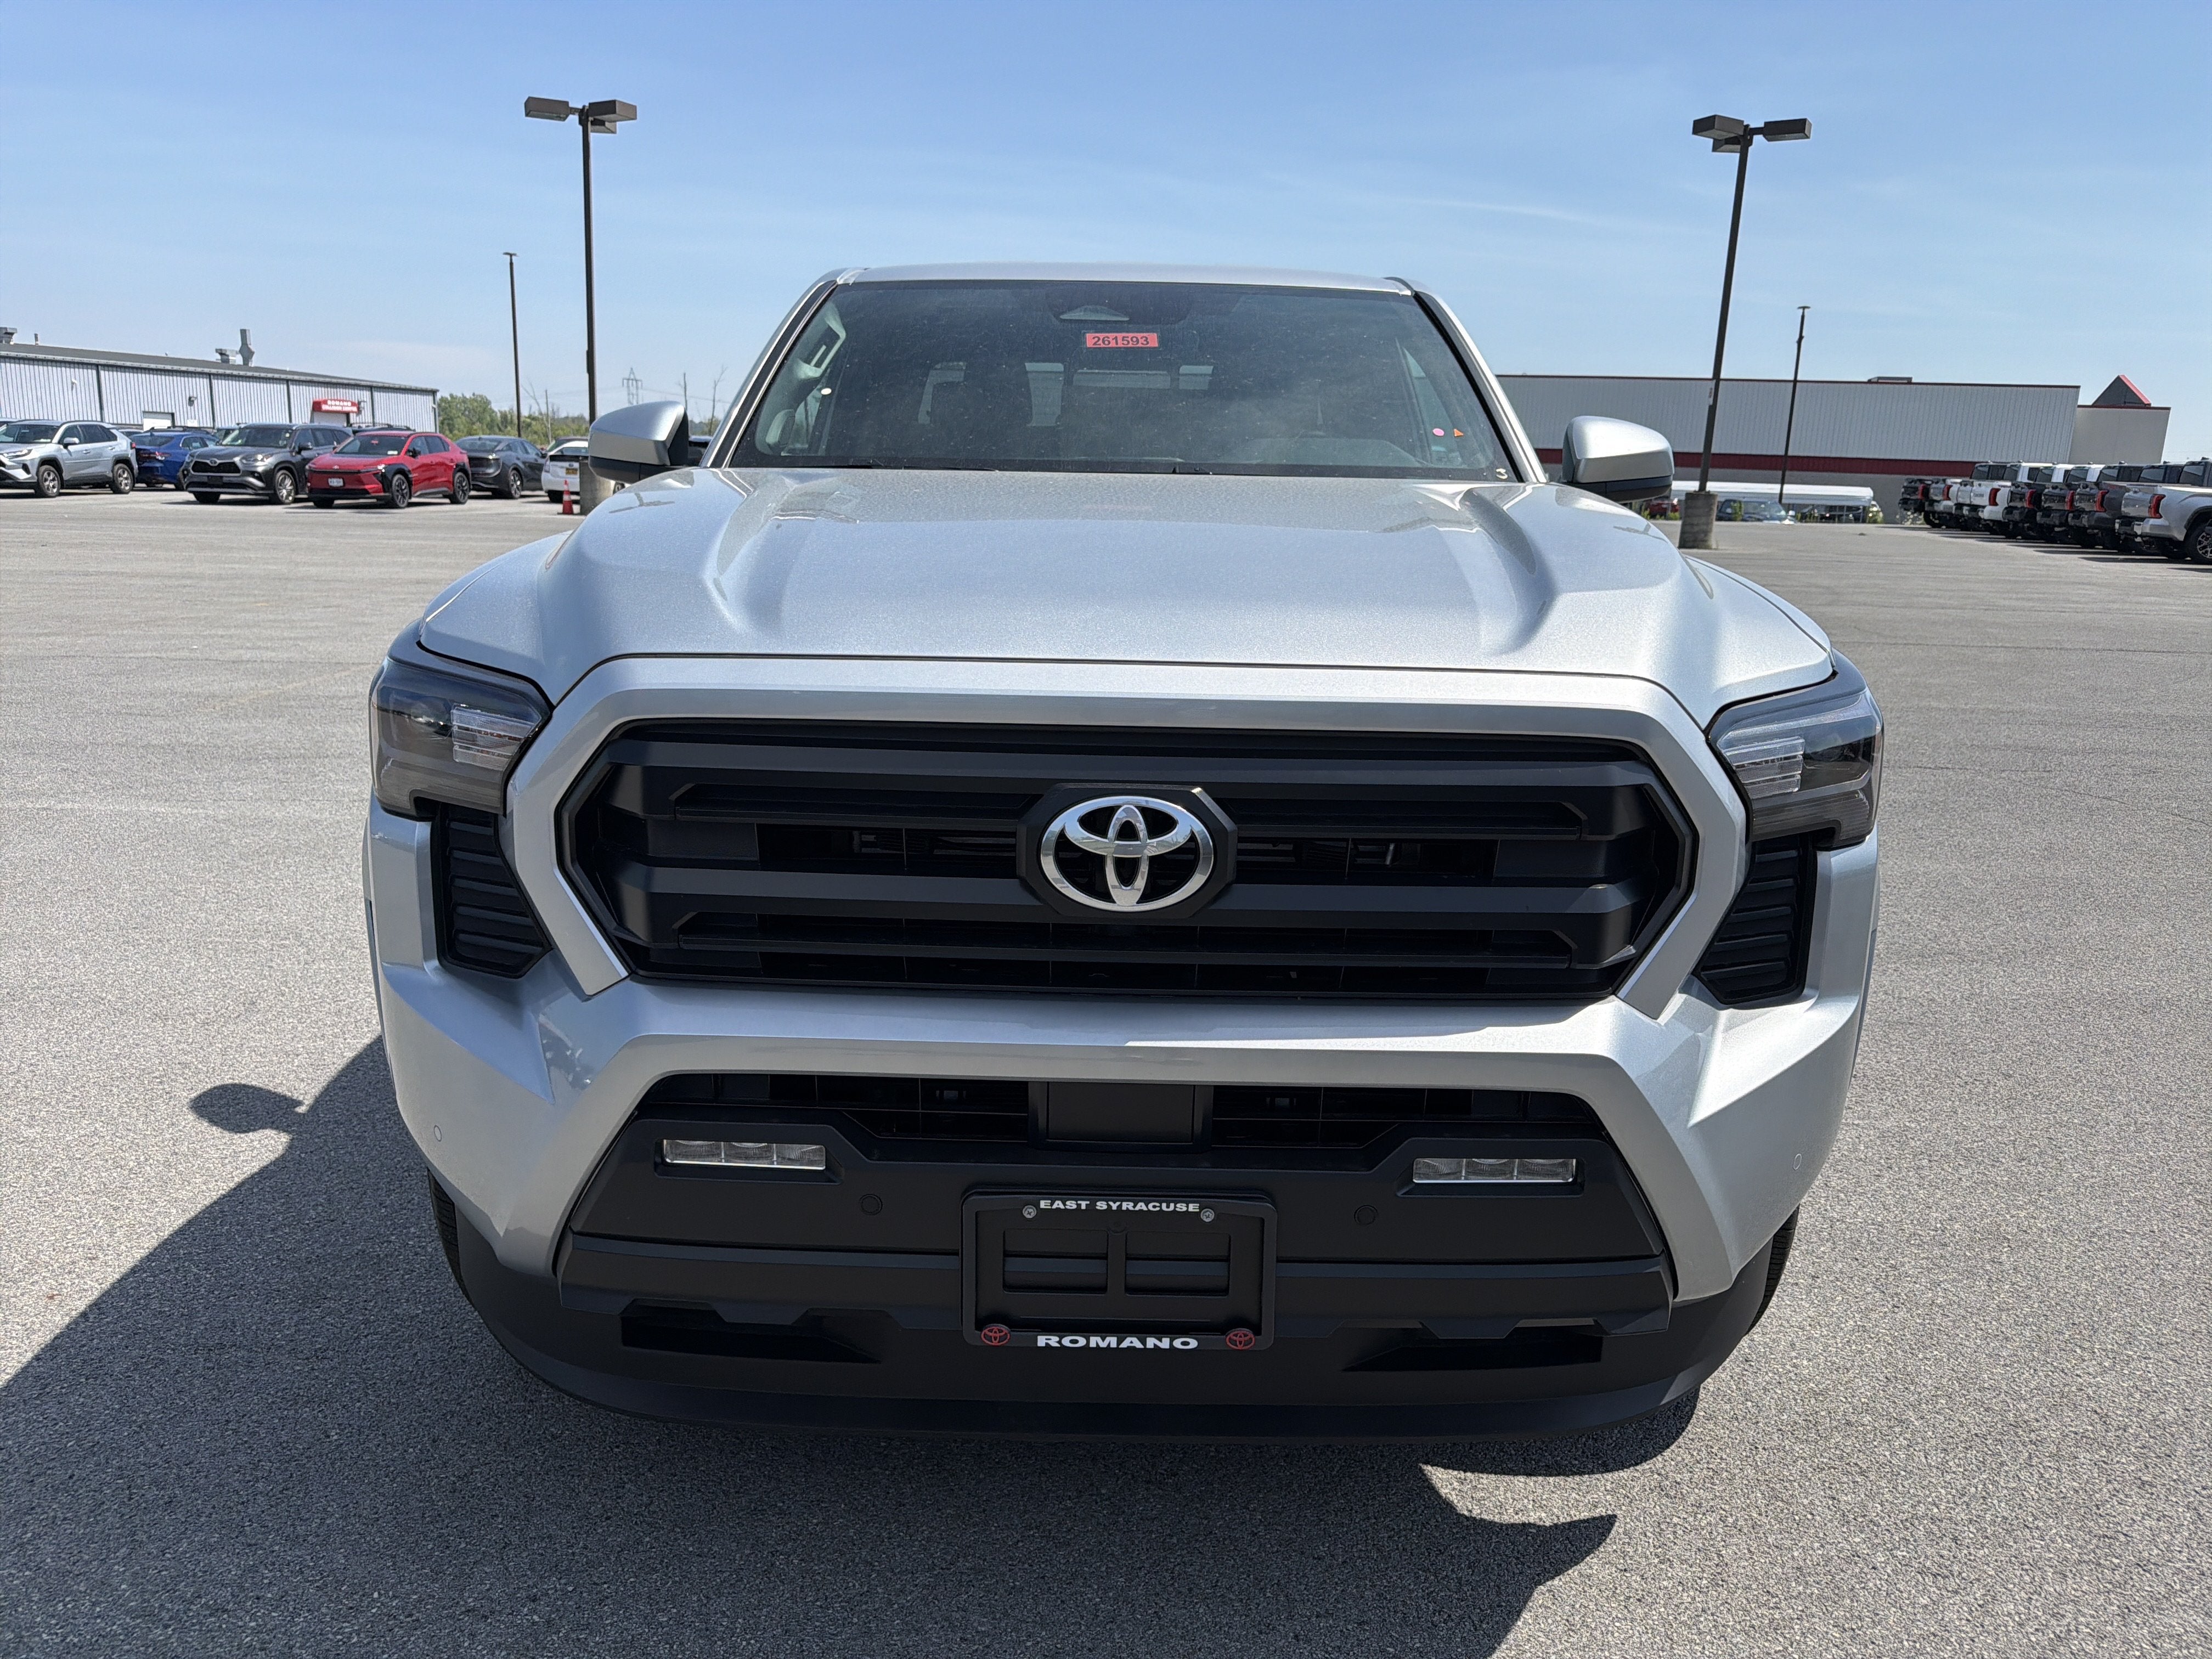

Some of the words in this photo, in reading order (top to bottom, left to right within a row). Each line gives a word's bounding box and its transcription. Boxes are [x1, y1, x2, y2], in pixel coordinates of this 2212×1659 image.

[1092, 336, 1149, 346] 261593
[1039, 1200, 1090, 1210] EAST
[1096, 1201, 1200, 1212] SYRACUSE
[1037, 1335, 1198, 1350] ROMANO
